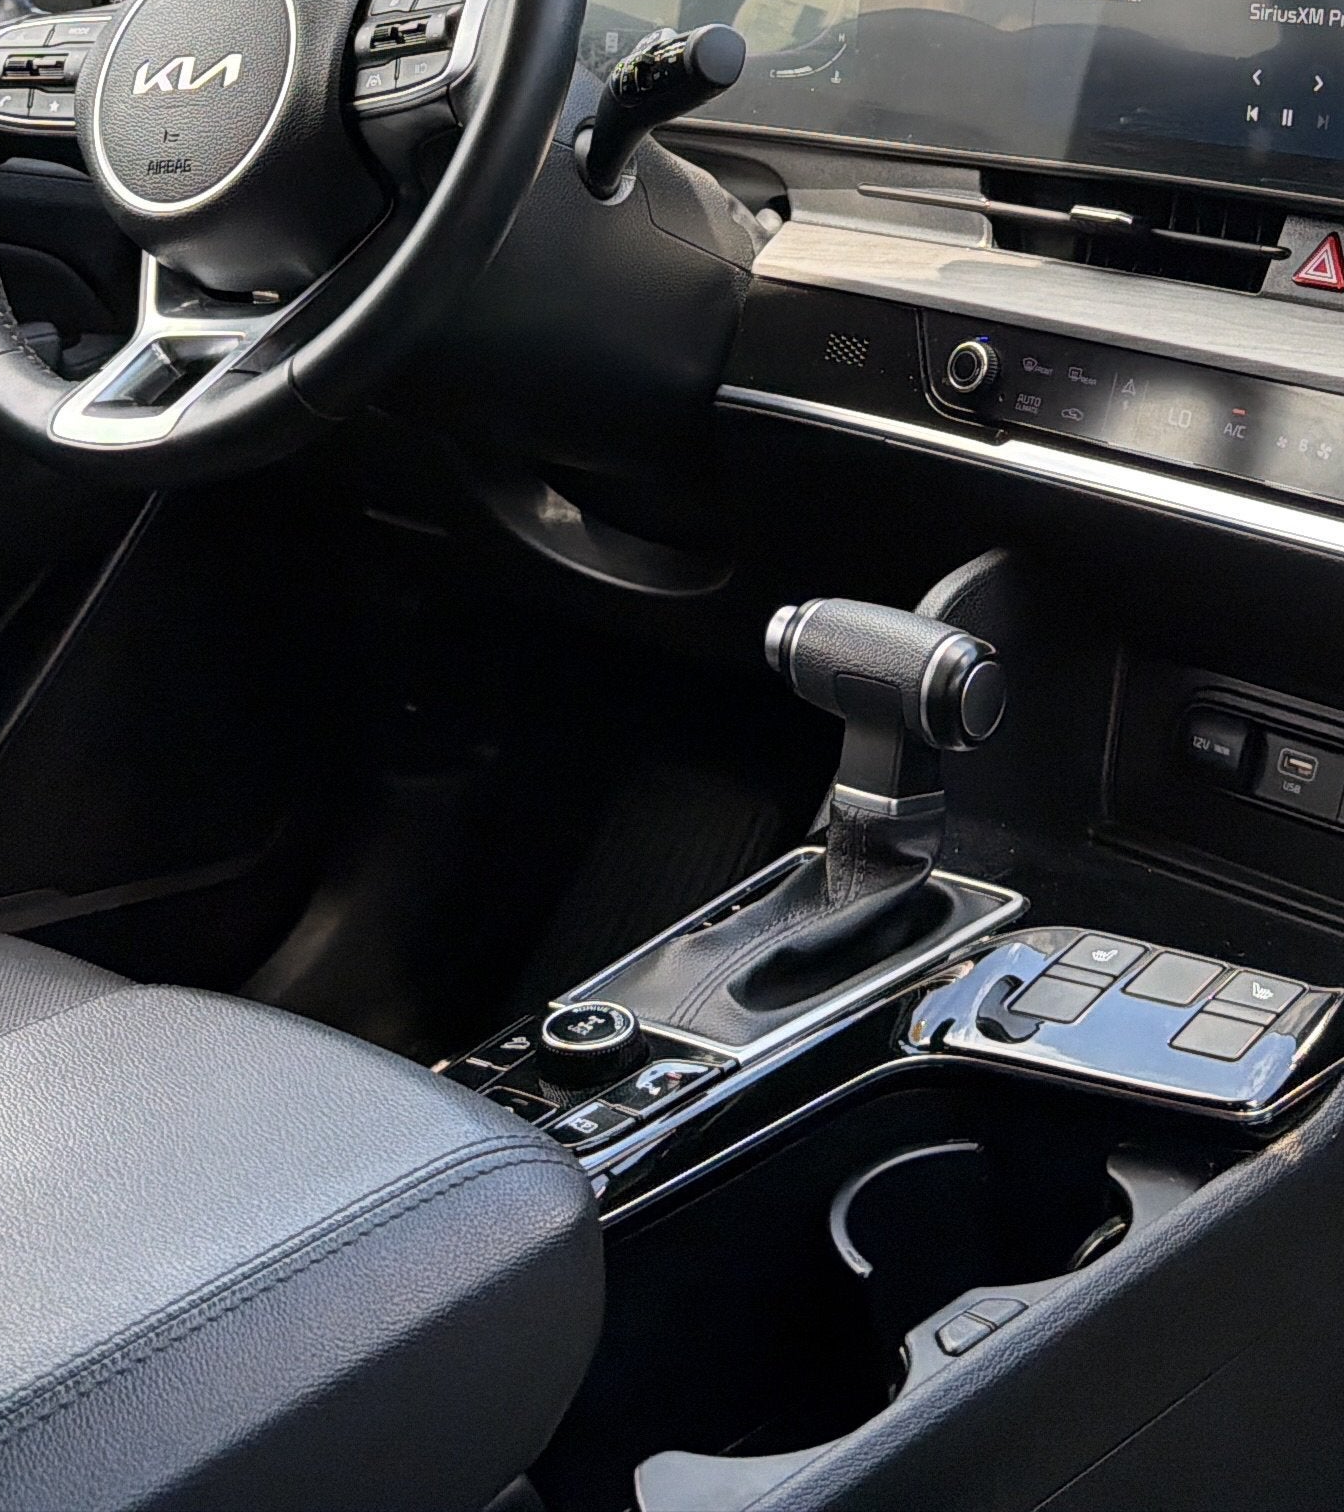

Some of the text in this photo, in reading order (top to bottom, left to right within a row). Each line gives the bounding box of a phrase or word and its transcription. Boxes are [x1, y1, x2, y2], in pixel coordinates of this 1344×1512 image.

[1249, 3, 1325, 26] SiriusXM
[131, 52, 243, 95] KIA
[1016, 393, 1042, 407] AUTO
[1168, 407, 1192, 429] LO
[1223, 422, 1247, 440] A/C
[1192, 735, 1211, 751] 12V
[1282, 780, 1302, 795] USB
